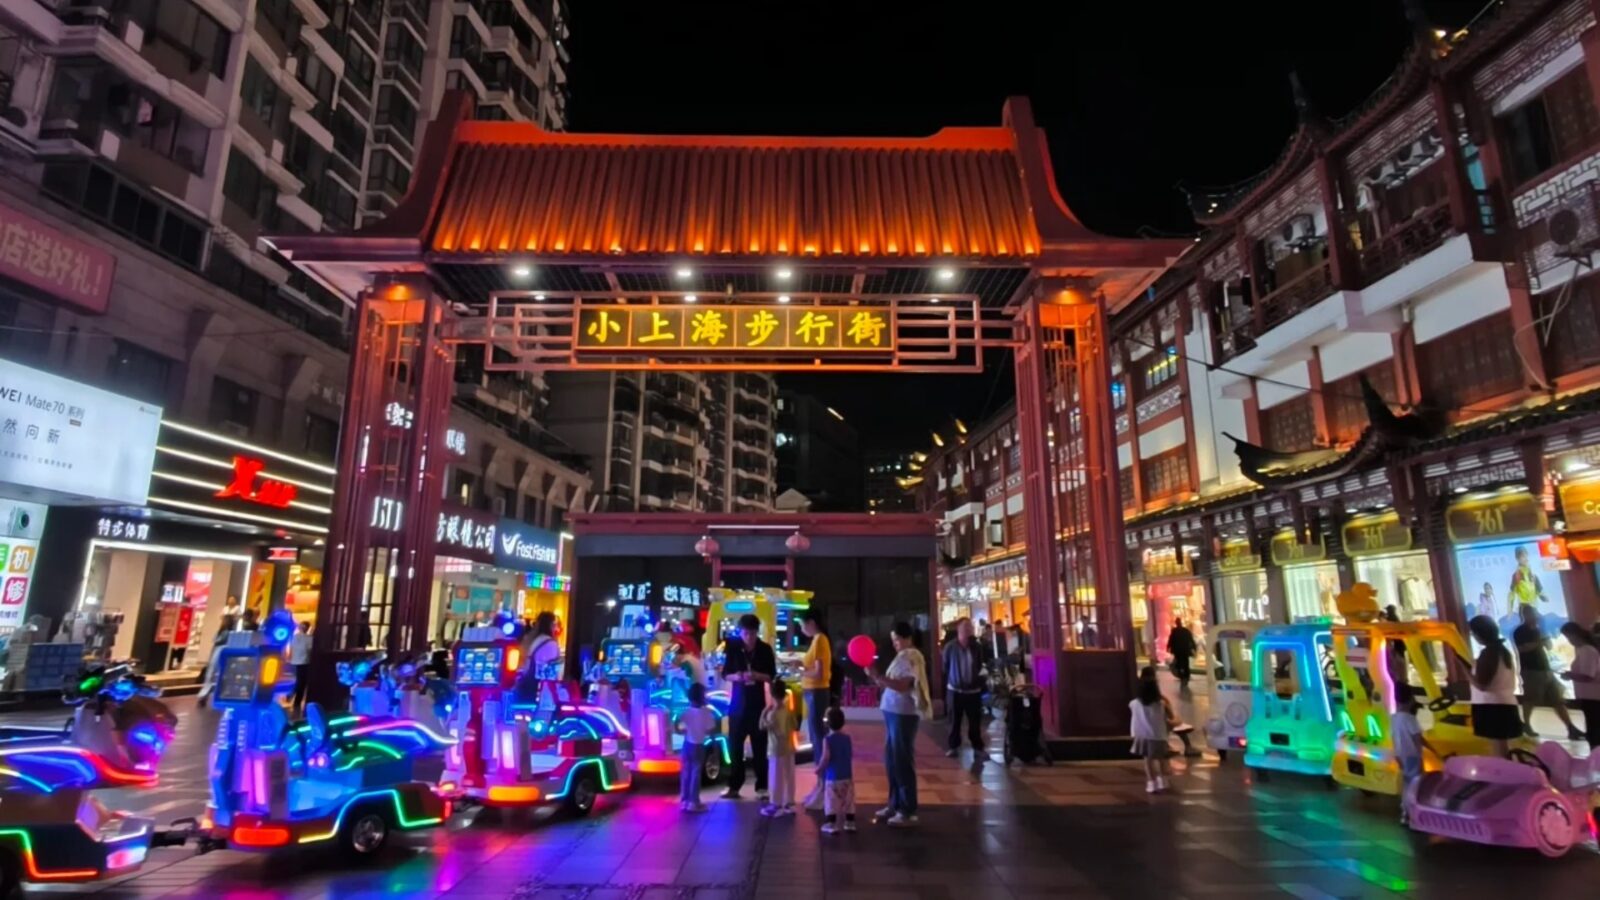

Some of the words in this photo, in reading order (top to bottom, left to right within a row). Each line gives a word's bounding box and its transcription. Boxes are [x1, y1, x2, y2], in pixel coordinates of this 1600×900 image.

[586, 309, 888, 347] 小上海步行街
[98, 517, 149, 540] 特步体育
